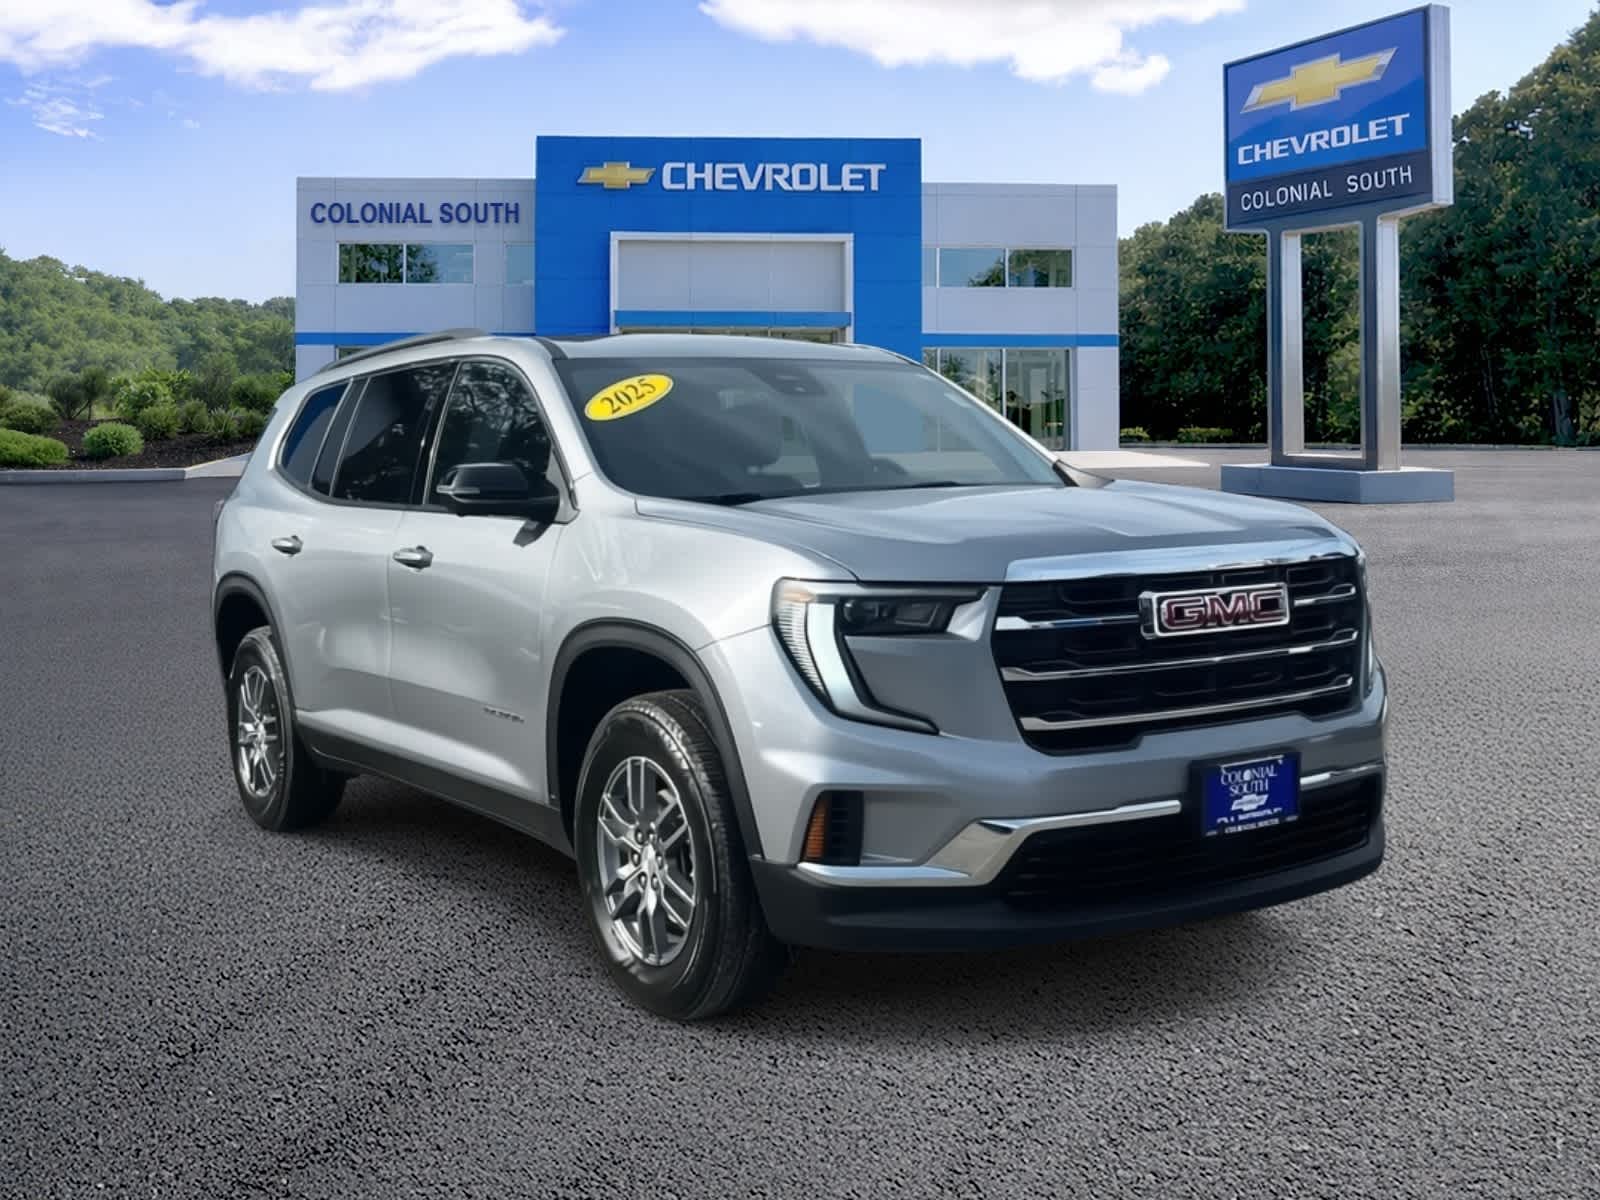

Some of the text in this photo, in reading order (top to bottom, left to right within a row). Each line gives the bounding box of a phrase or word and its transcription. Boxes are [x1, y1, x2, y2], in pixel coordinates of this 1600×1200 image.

[1237, 113, 1410, 165] CHEVROLET
[661, 161, 887, 192] CHEVROLET
[1240, 165, 1412, 211] COLONIAL SOUTH
[310, 202, 520, 225] COLONIAL SOUTH
[600, 379, 656, 414] 2025
[1160, 589, 1286, 630] GMC
[1220, 764, 1278, 785] COLONIAL
[1229, 778, 1269, 797] SOUTH
